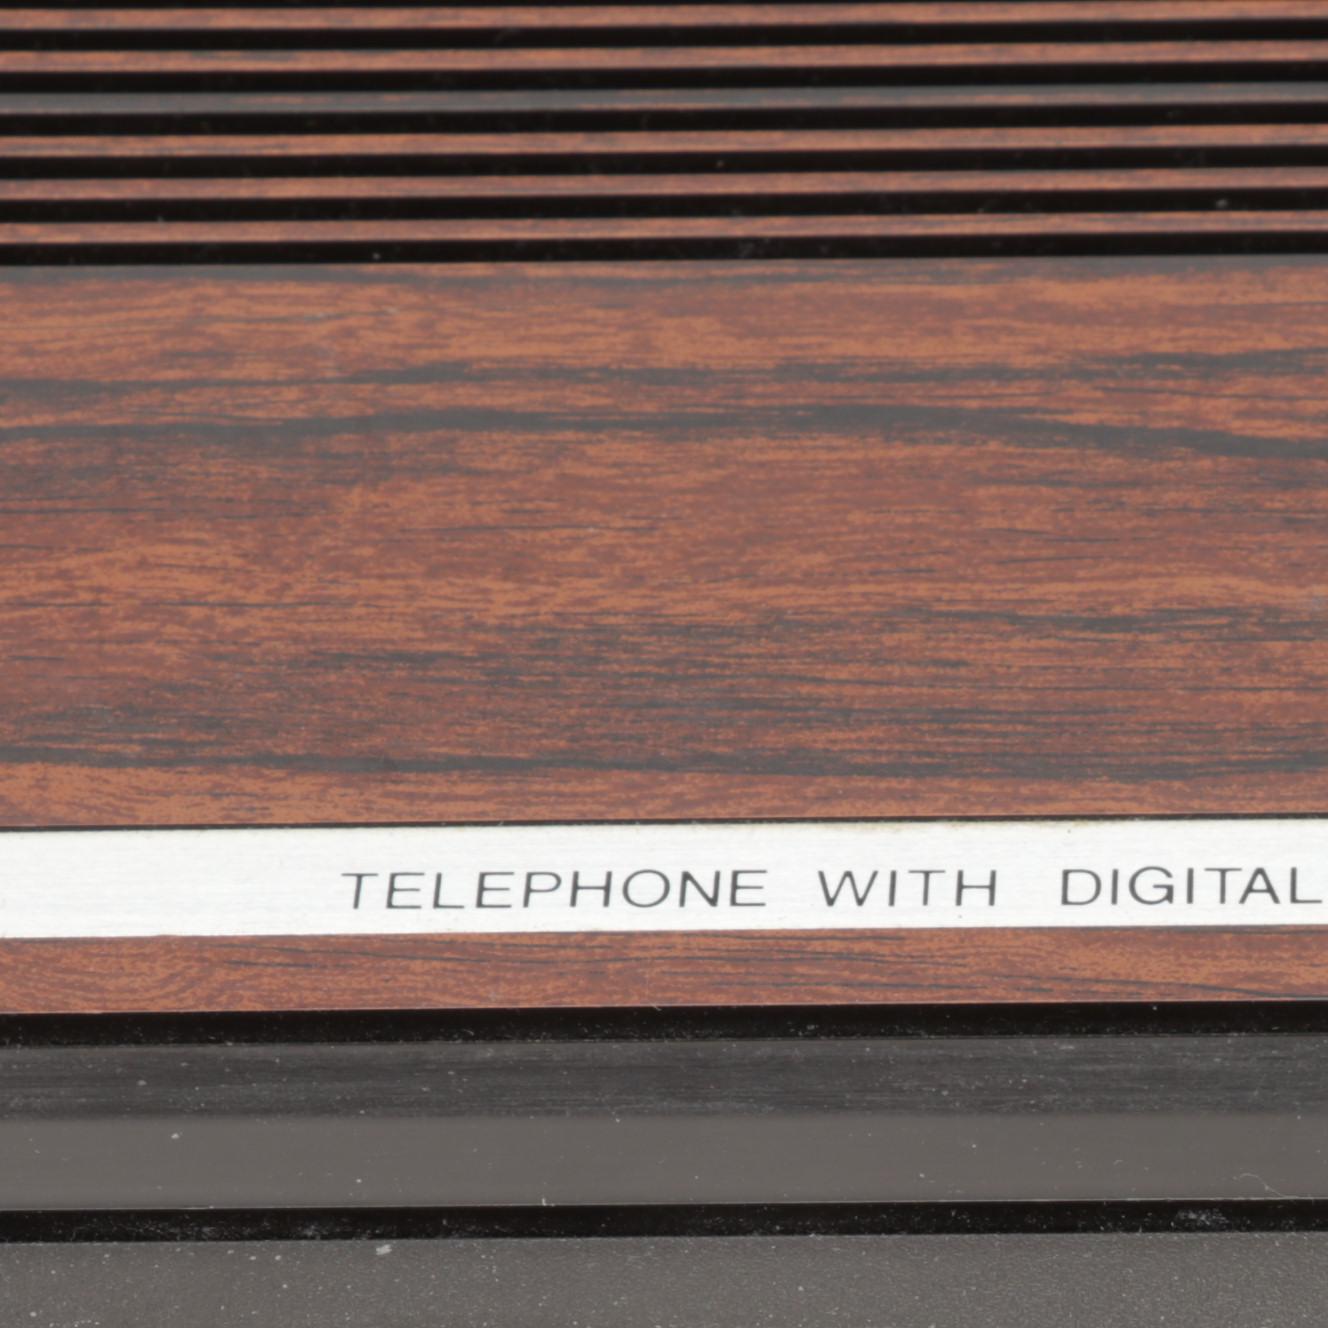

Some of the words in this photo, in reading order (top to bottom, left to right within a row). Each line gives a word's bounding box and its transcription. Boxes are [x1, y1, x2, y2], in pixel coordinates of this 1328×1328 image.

[341, 869, 767, 910] TELEPHONE
[818, 869, 997, 907] WITH
[1061, 866, 1323, 906] DIGITAL
